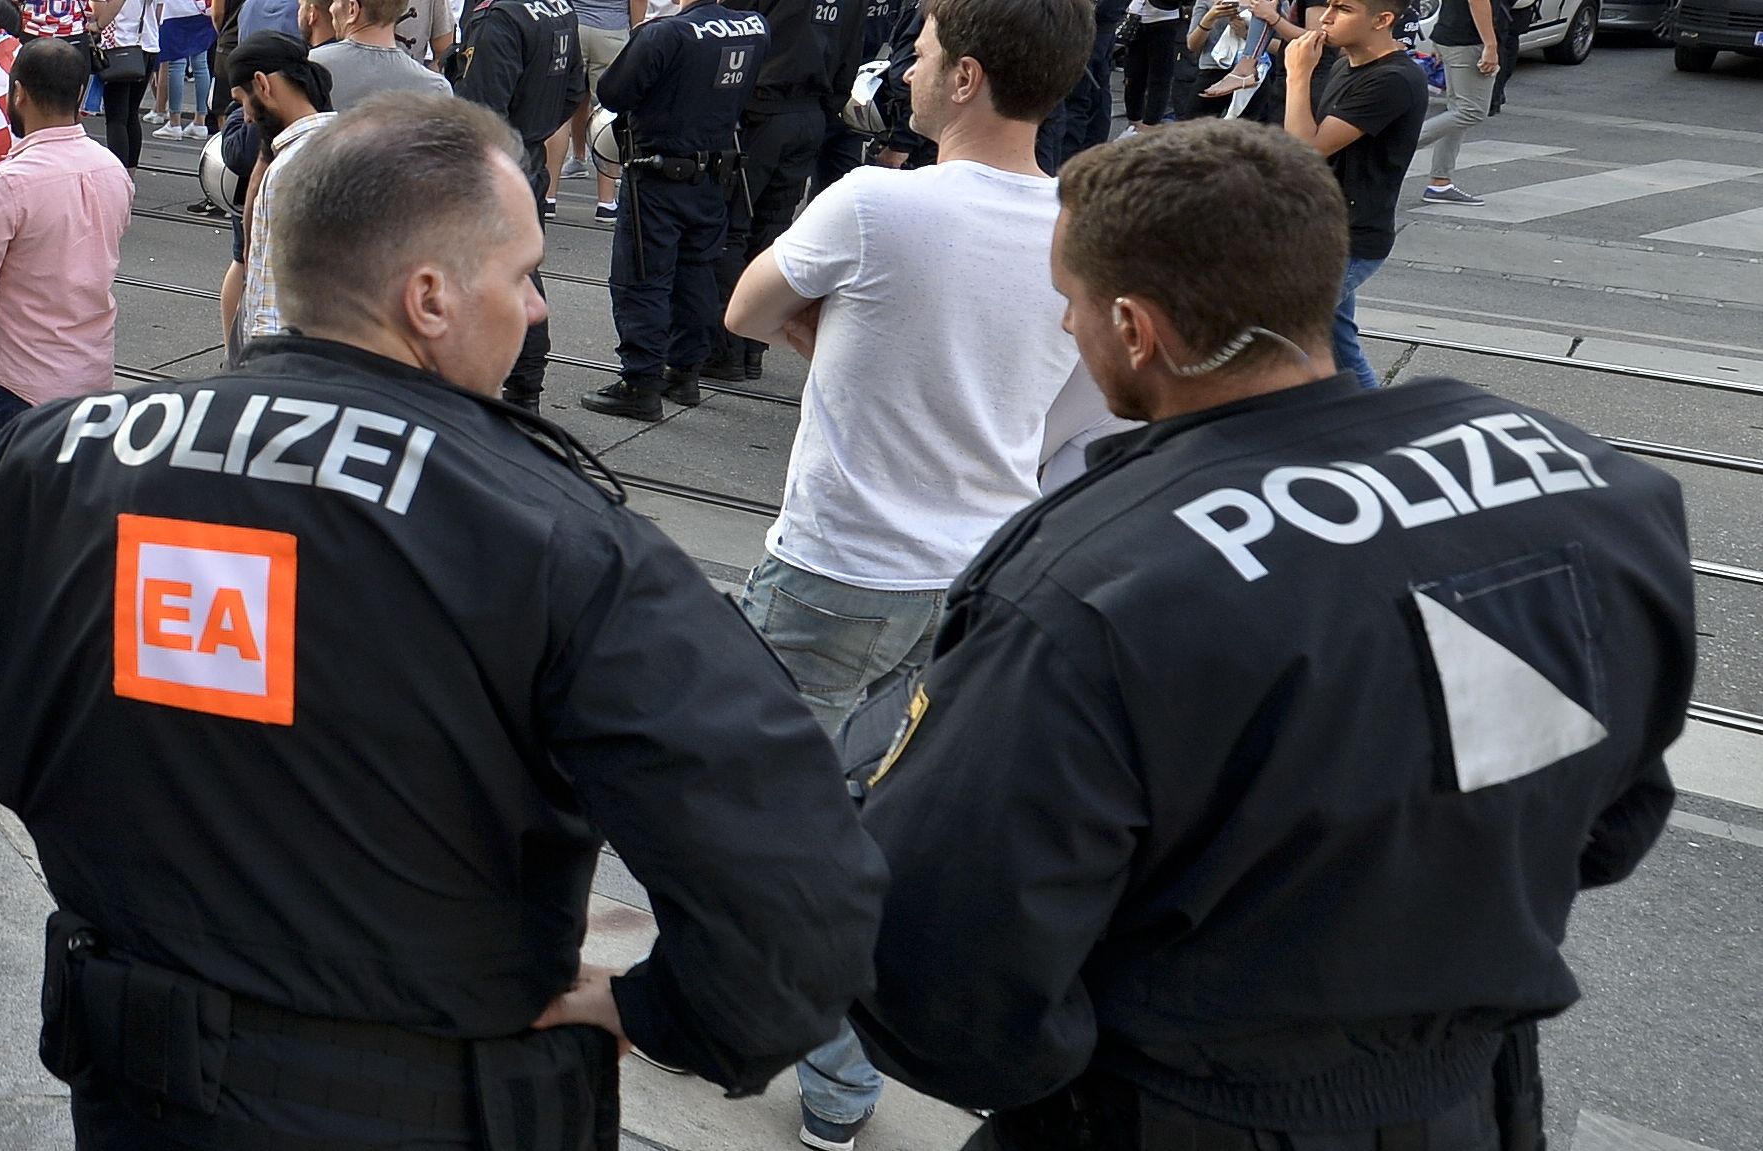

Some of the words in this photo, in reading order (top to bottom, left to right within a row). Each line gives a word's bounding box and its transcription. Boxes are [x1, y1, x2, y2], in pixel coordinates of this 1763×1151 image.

[815, 5, 838, 21] 210
[867, 5, 889, 17] 210
[560, 35, 569, 54] U
[729, 51, 745, 69] U
[721, 72, 743, 84] 210
[56, 389, 437, 516] POLIZEI
[1174, 412, 1609, 582] POLIZEI
[143, 578, 261, 661] EA
